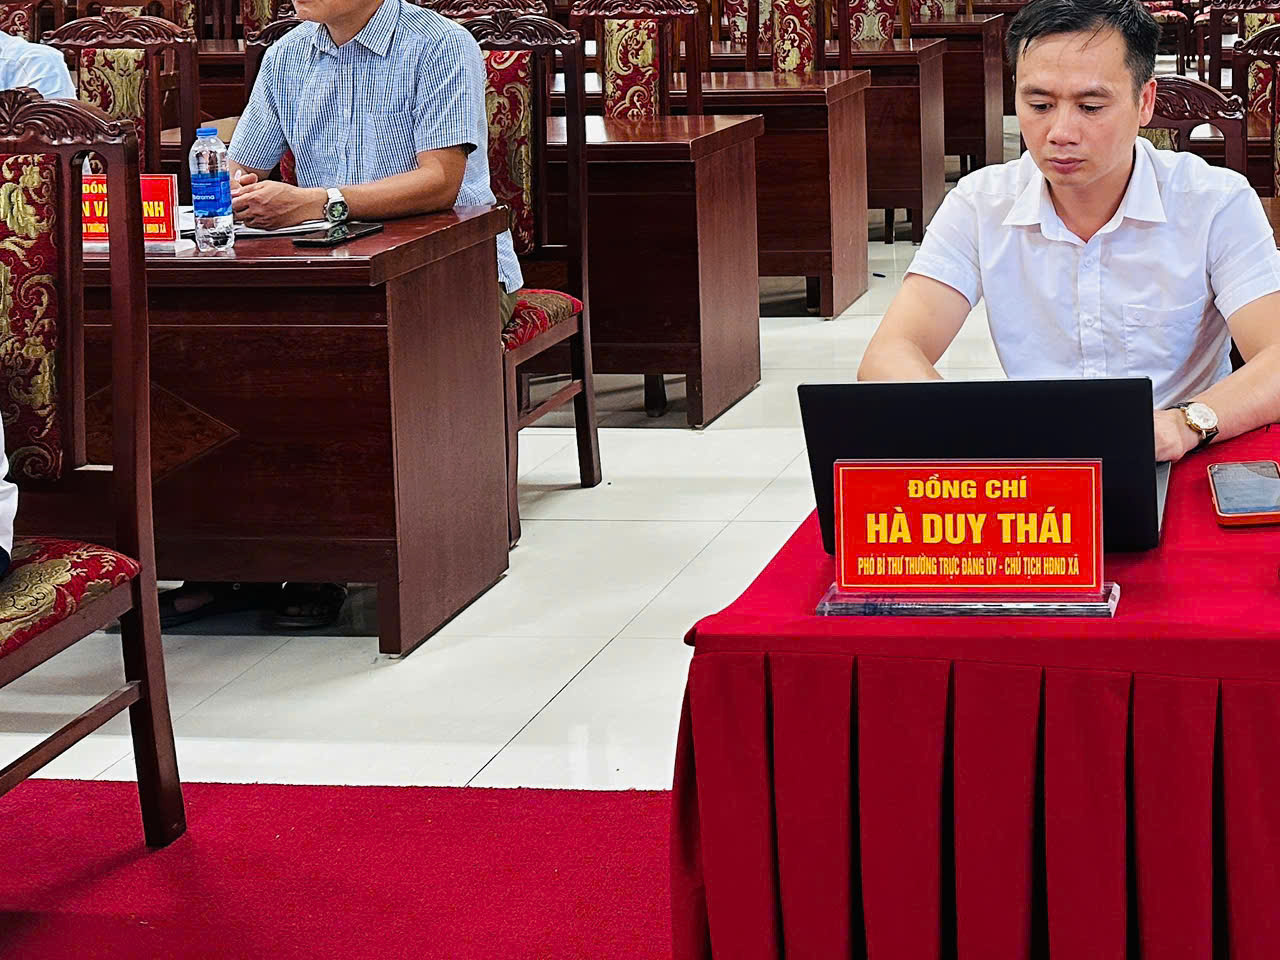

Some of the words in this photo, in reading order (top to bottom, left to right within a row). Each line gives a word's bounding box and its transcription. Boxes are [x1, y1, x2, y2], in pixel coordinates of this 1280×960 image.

[143, 201, 164, 217] NH
[908, 473, 977, 499] ĐỒNG
[985, 475, 1027, 498] CHÍ
[866, 506, 912, 544] HÀ
[922, 513, 986, 544] DUY
[997, 506, 1072, 544] THÁI
[857, 553, 875, 575] PHÓ
[876, 553, 886, 575] BÍ
[905, 552, 937, 575] THƯỜNG
[938, 555, 960, 579] TRỰC
[961, 551, 984, 575] ĐẢNG
[986, 551, 997, 575] ỦY
[1005, 551, 1021, 575] CHỦ
[1023, 557, 1041, 579] TỊCH
[1068, 553, 1080, 575] XÃ
